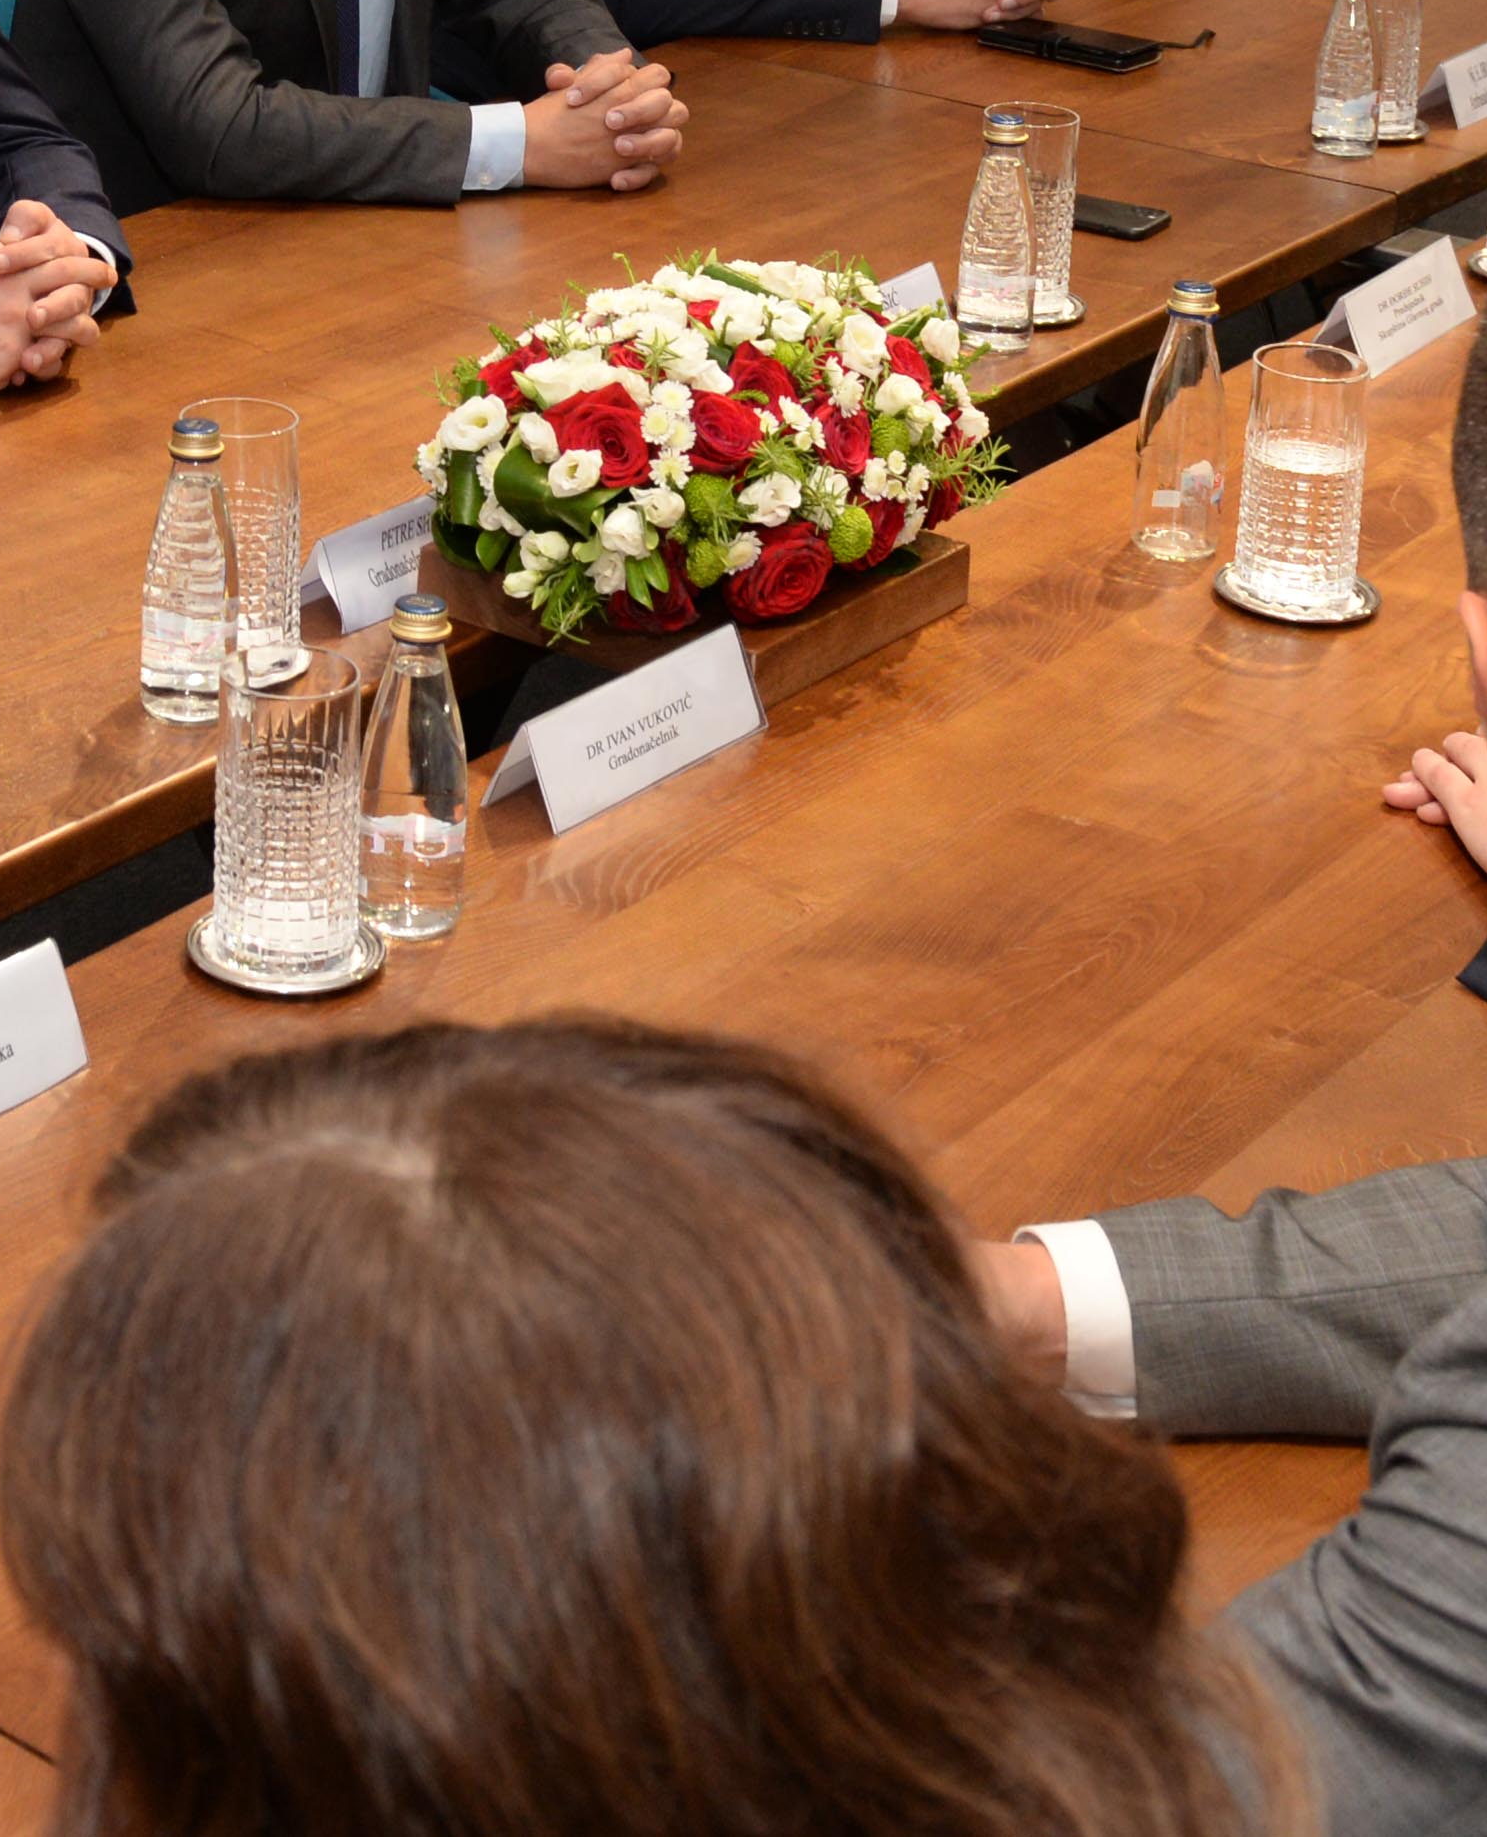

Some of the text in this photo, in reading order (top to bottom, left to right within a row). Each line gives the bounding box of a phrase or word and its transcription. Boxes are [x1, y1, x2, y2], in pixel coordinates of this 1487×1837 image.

[380, 518, 415, 551] PETRE
[585, 690, 694, 761] DR IVAN VUKOVIĆ
[607, 723, 680, 772] Gradonačelnik
